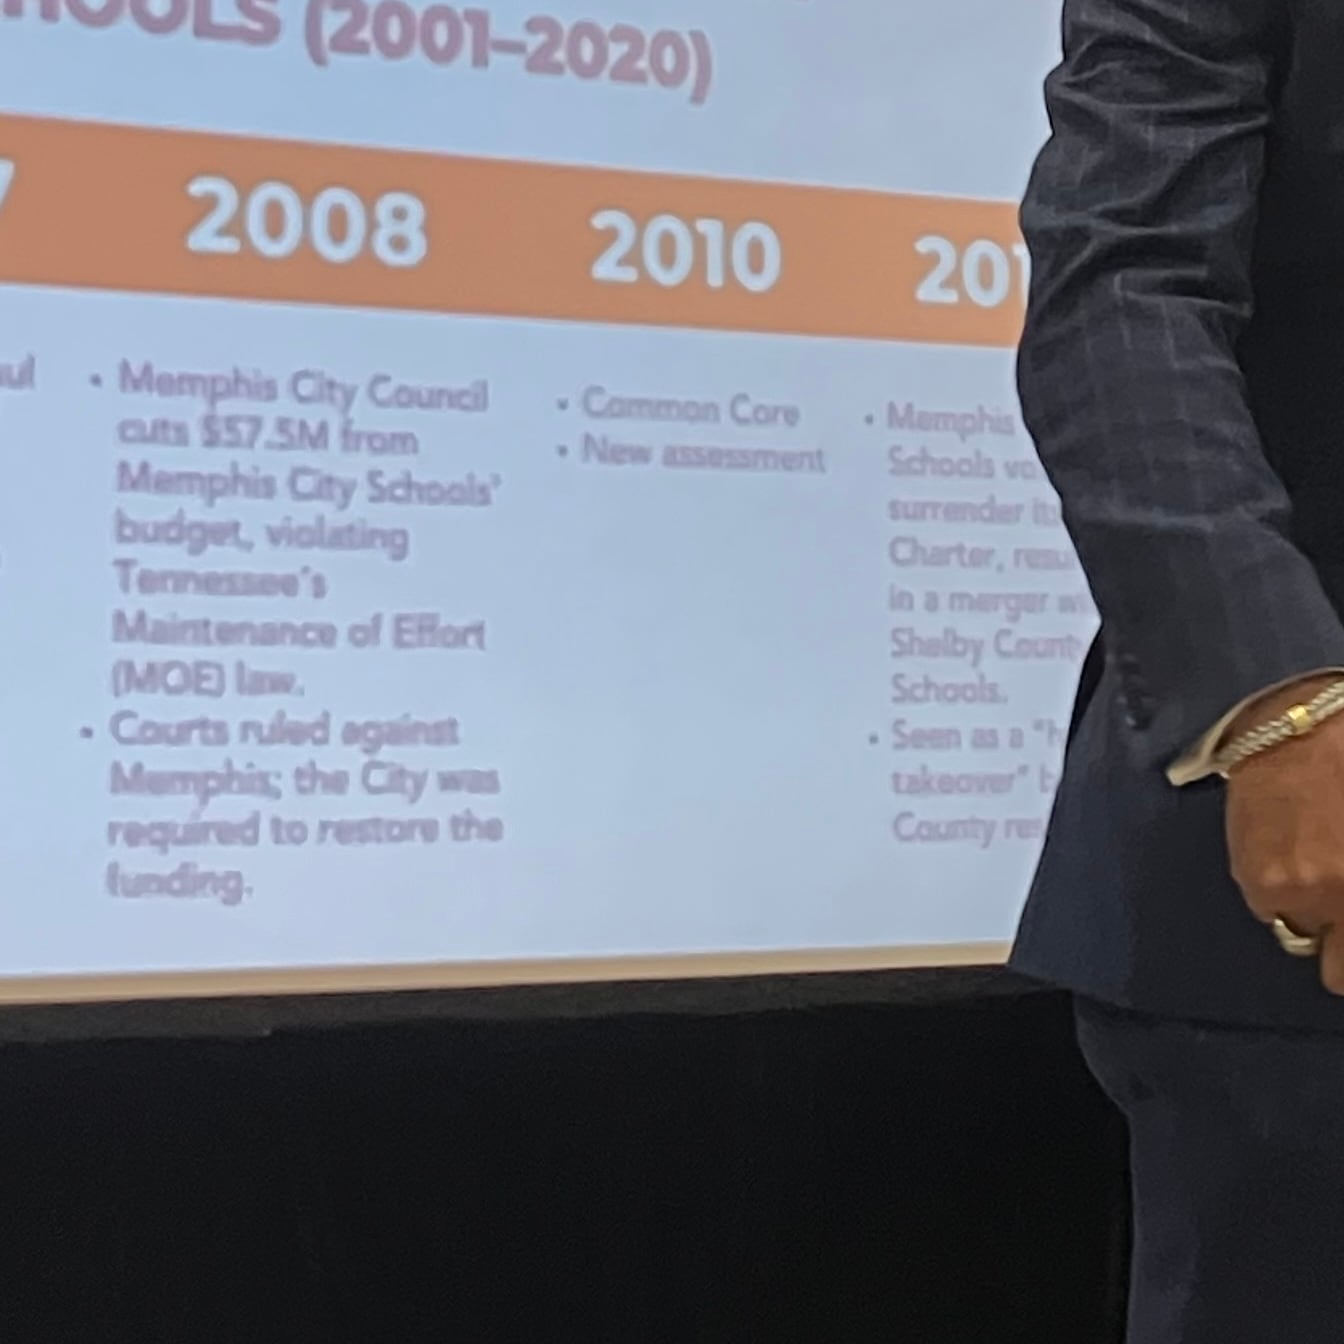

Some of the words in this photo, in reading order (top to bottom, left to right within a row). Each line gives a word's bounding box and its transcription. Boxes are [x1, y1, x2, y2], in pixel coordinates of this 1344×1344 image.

[186, 174, 427, 267] 2008
[589, 209, 781, 293] 2010
[118, 358, 278, 412] Memphis
[289, 369, 358, 413] City
[366, 375, 488, 412] Council
[581, 385, 721, 424] Common
[729, 392, 800, 427] Core
[117, 419, 188, 447] cuts
[341, 421, 418, 454] from
[887, 401, 1015, 443] Memphis
[582, 432, 652, 465] New
[662, 444, 826, 473] assessment
[888, 445, 995, 479] Schools
[116, 460, 276, 507] Memphis
[288, 466, 357, 509] City
[888, 494, 1024, 524] surrender
[114, 508, 254, 556] budget,
[265, 516, 410, 560] violating
[889, 536, 1004, 573] Charter,
[890, 584, 914, 611] in
[924, 592, 940, 612] a
[950, 593, 1048, 623] merger
[111, 610, 337, 648] Maintenance
[347, 612, 383, 648] of
[393, 612, 486, 650] Effort
[891, 627, 984, 668] Shelby
[111, 660, 226, 699] (MOE)
[236, 662, 304, 697] law.
[891, 672, 1008, 704] Schools.
[109, 710, 229, 746] Courts
[239, 710, 331, 746] ruled
[340, 714, 459, 754] against
[891, 718, 961, 750] Seen
[971, 728, 999, 749] as
[1009, 729, 1024, 748] a
[294, 761, 349, 795] the
[361, 760, 429, 803] City
[437, 768, 501, 795] was
[106, 809, 261, 854] required
[270, 816, 309, 845] to
[317, 816, 440, 844] restore
[449, 808, 504, 843] the
[893, 811, 997, 849] County
[105, 862, 253, 907] funding.
